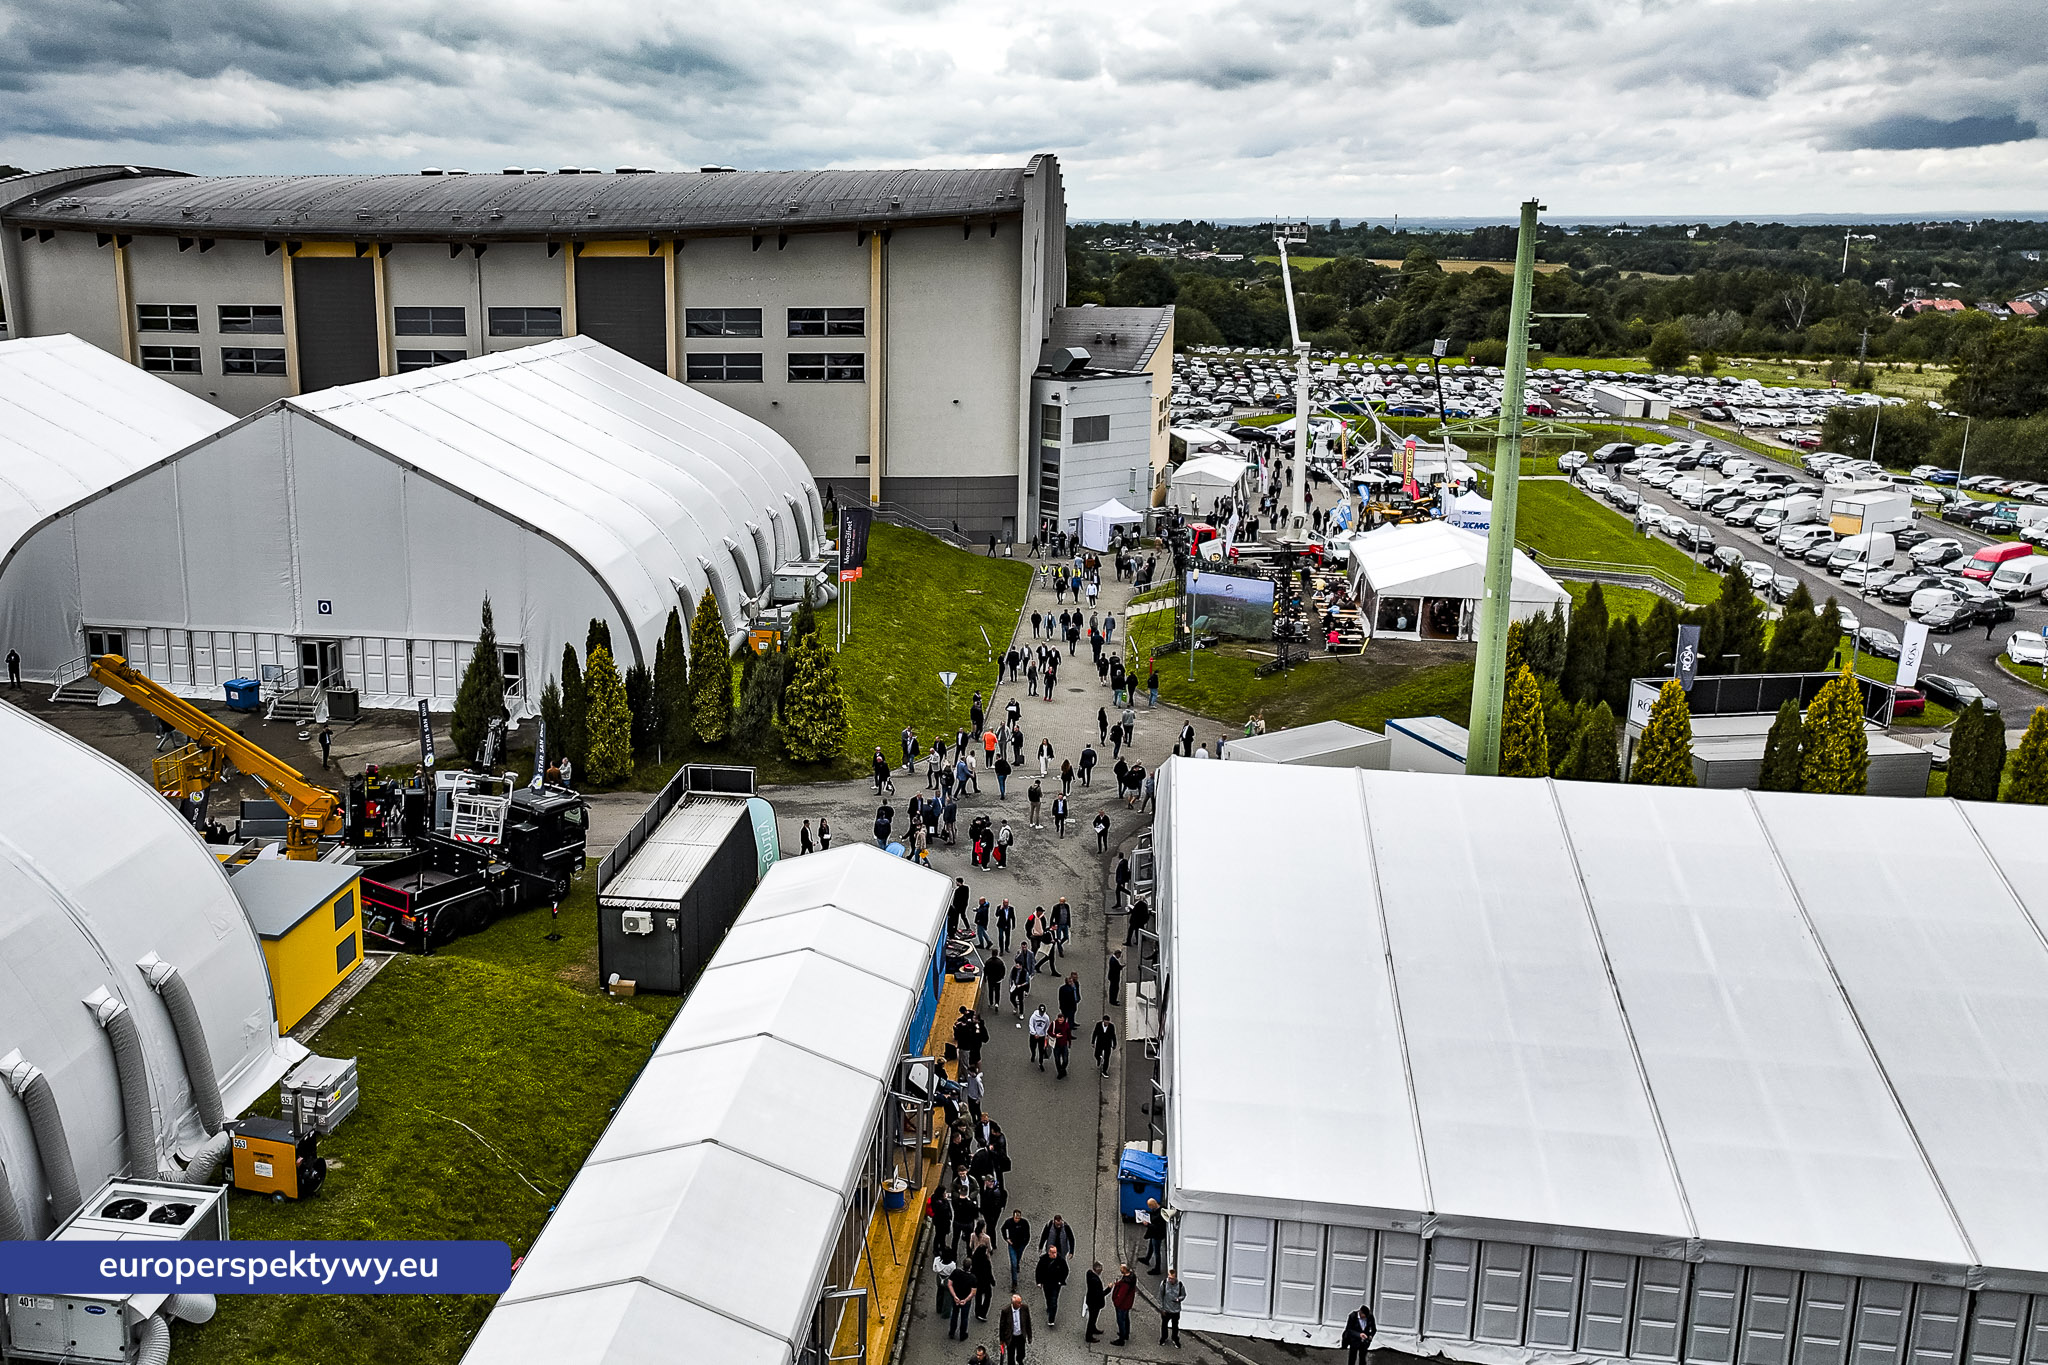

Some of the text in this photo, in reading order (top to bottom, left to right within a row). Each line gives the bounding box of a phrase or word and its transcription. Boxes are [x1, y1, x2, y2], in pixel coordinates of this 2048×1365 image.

[1461, 521, 1490, 530] XCMG
[1682, 644, 1693, 672] ROSA
[1905, 642, 1918, 667] ROSA
[1637, 699, 1651, 713] RO
[425, 733, 433, 751] STAR
[234, 1139, 246, 1149] 553
[19, 1297, 34, 1307] 401
